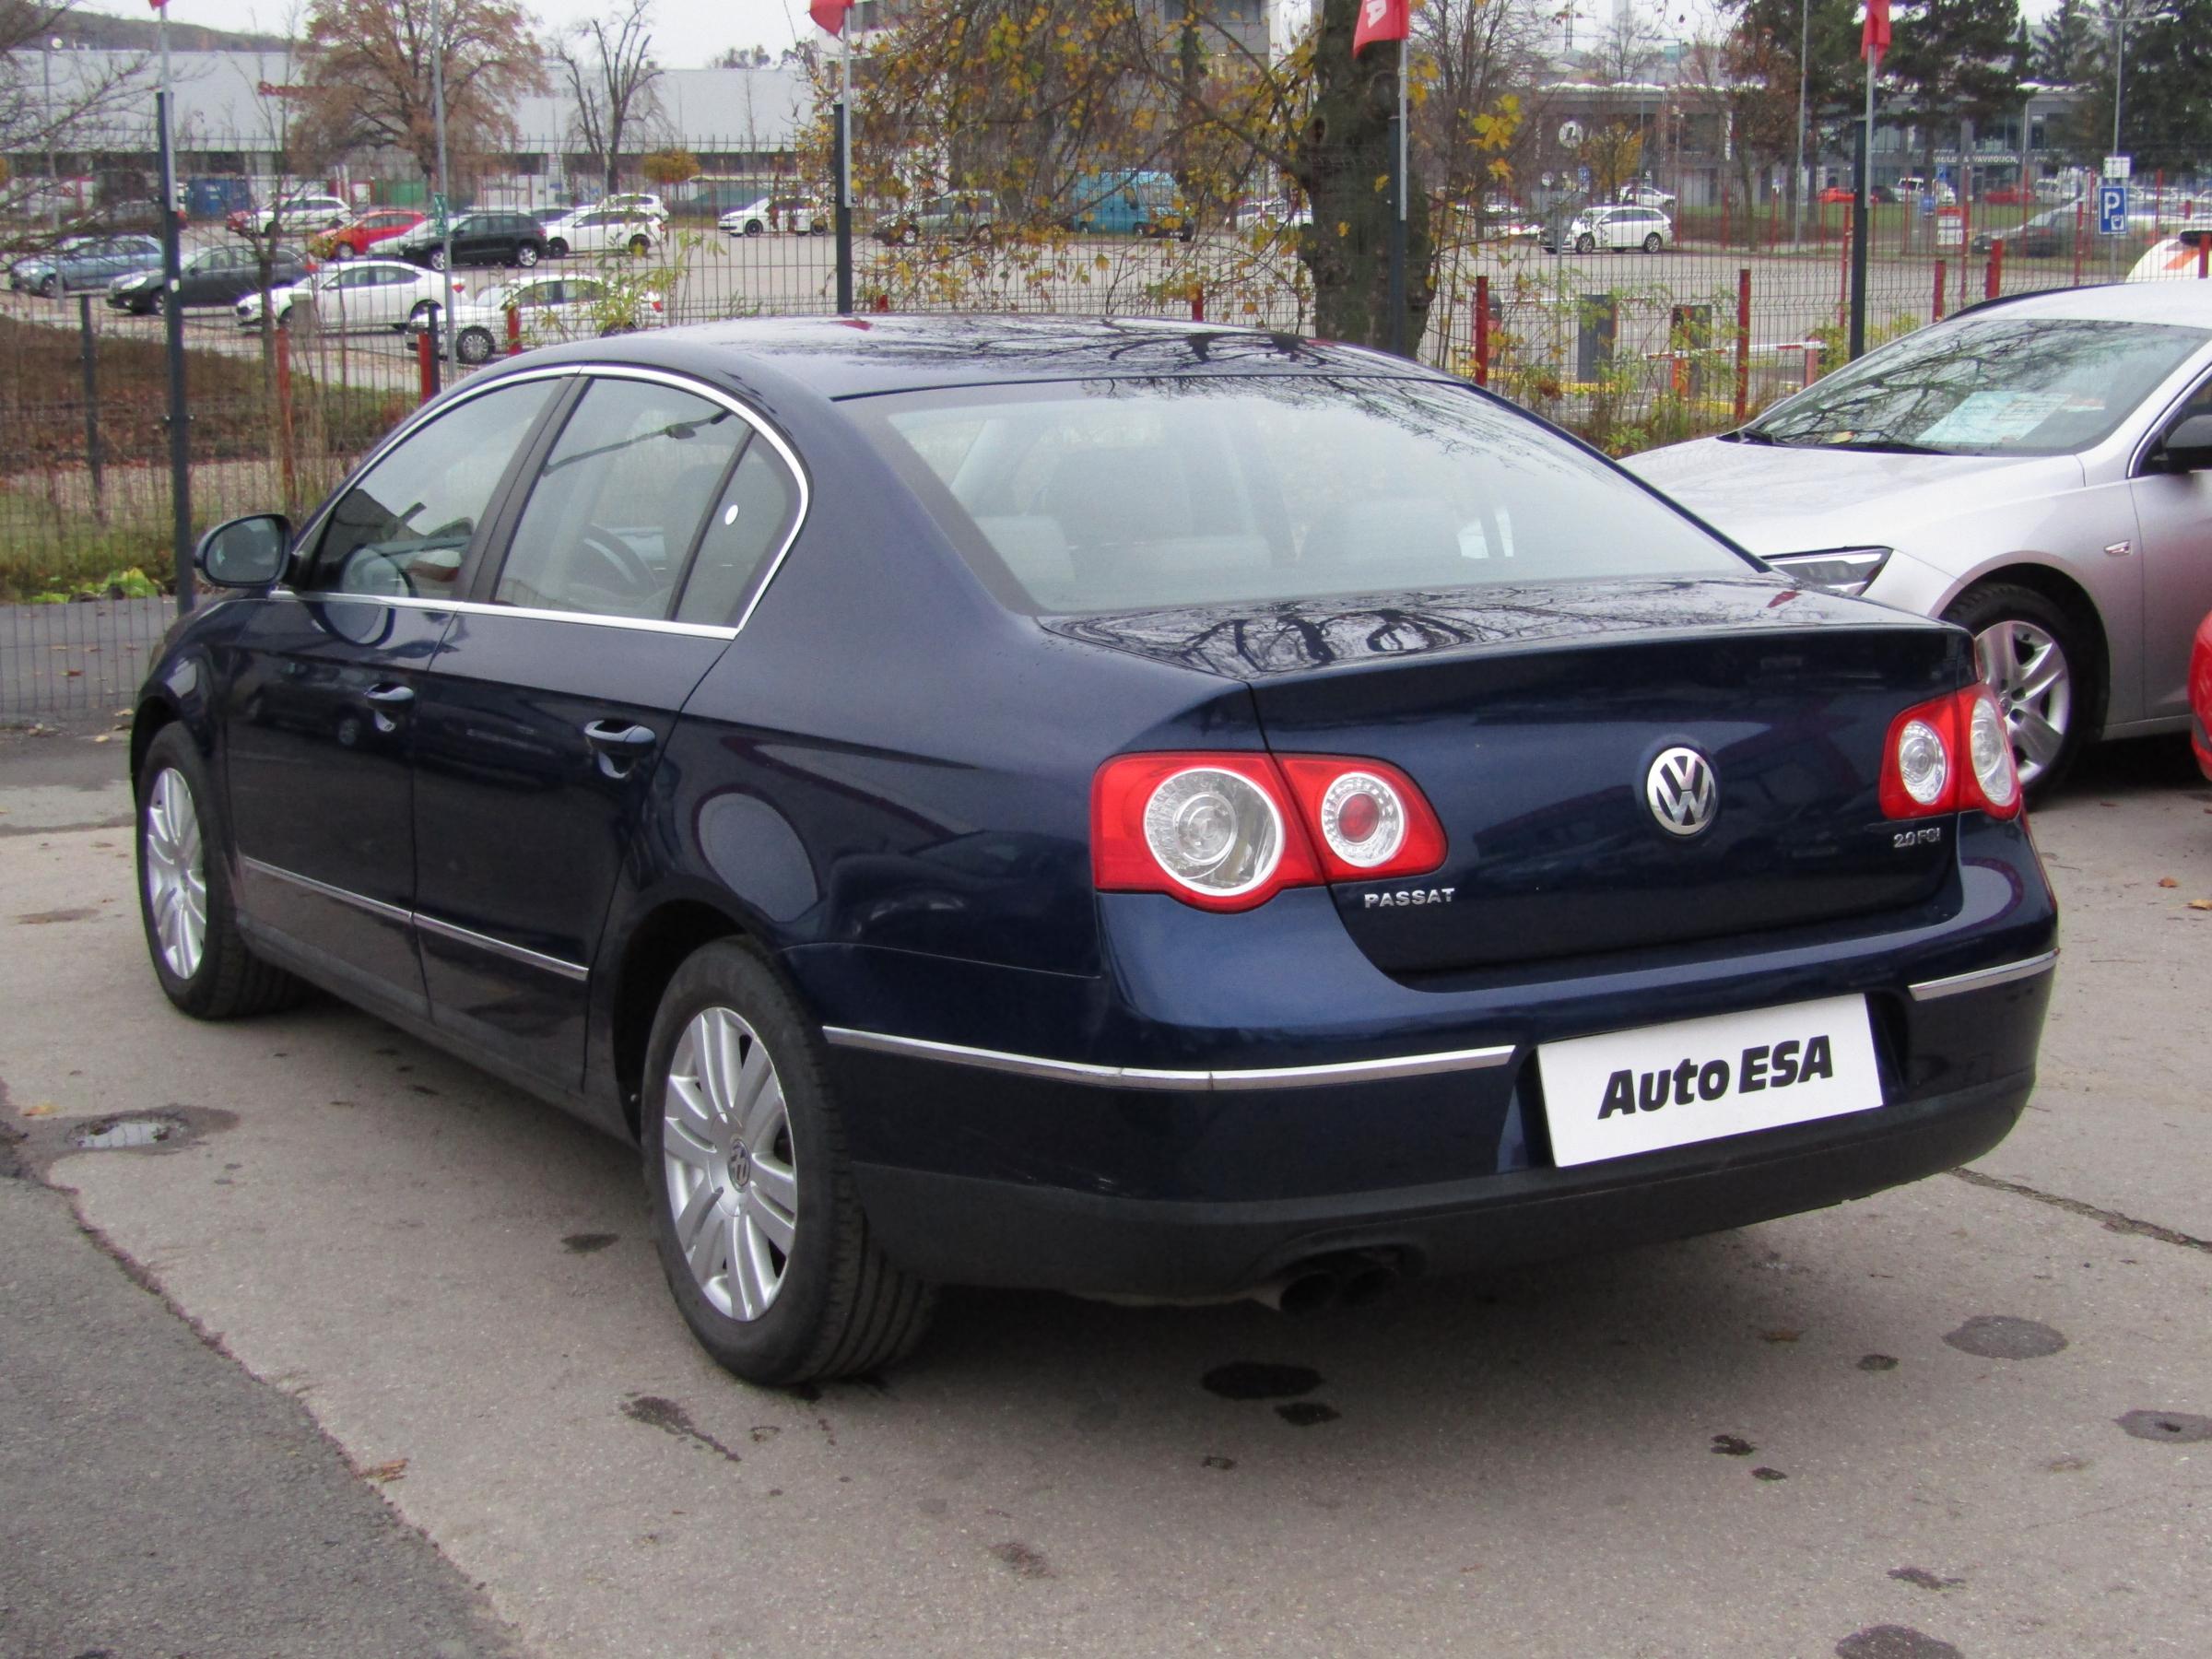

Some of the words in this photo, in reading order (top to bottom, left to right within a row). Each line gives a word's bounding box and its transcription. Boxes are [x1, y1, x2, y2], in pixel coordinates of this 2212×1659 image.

[2104, 191, 2121, 219] P
[1364, 887, 1455, 909] PASSAT
[1597, 1058, 1730, 1120] Auto
[1738, 1035, 1833, 1094] ESA
